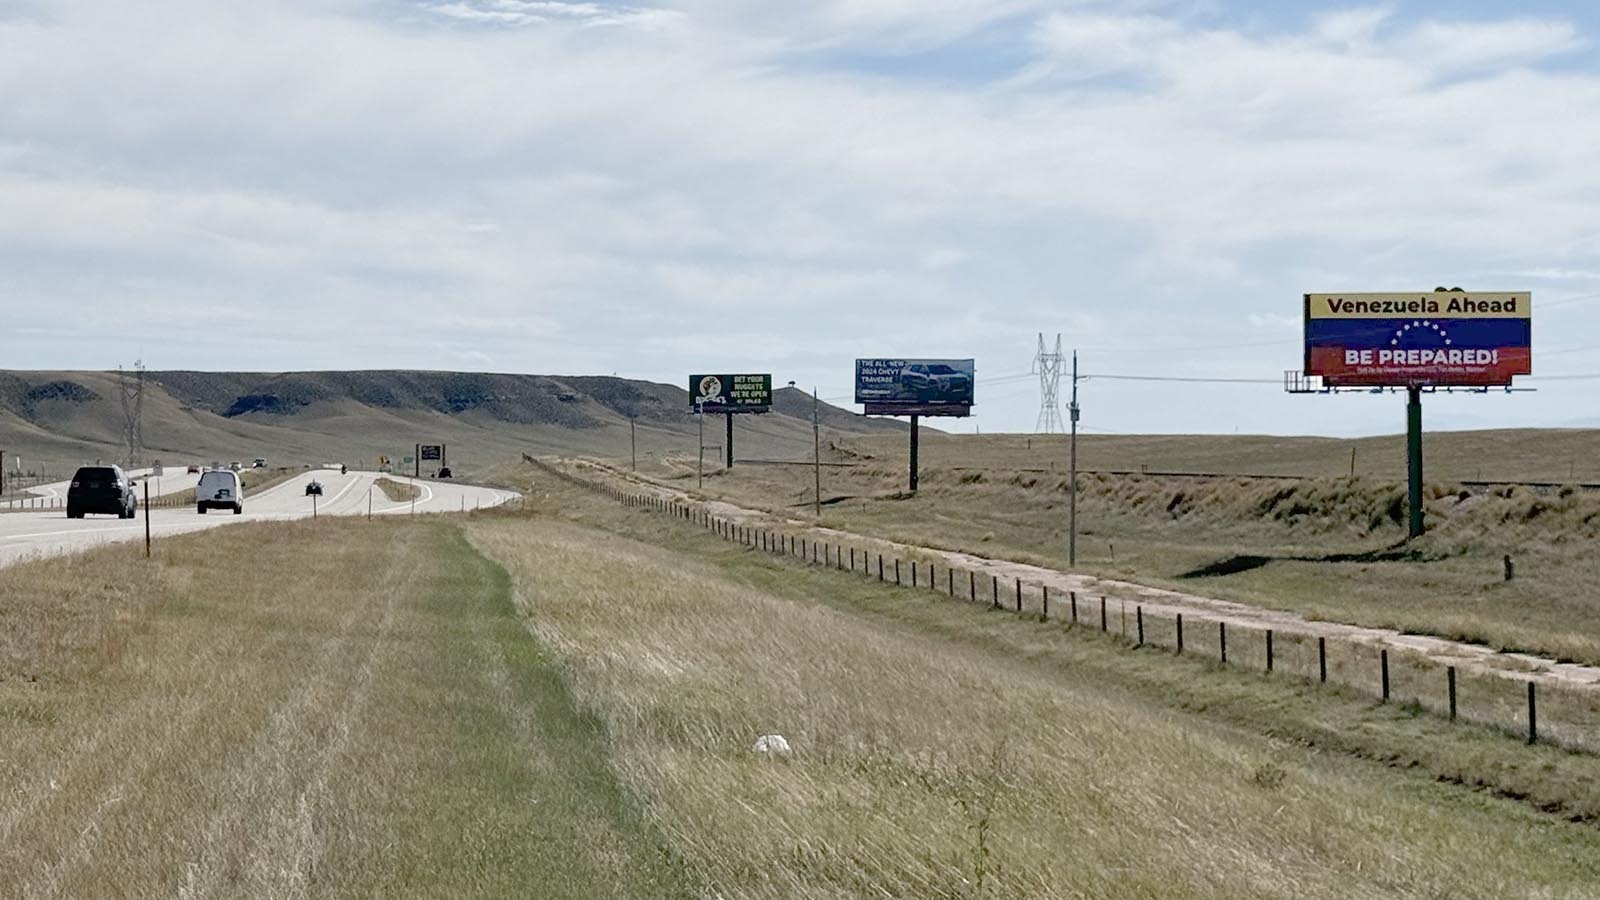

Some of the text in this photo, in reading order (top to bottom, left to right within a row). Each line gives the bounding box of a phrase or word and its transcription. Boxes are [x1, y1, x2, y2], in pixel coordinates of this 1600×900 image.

[1327, 297, 1516, 313] Venezuela Ahead
[1345, 350, 1499, 365] BE PREPARED!
